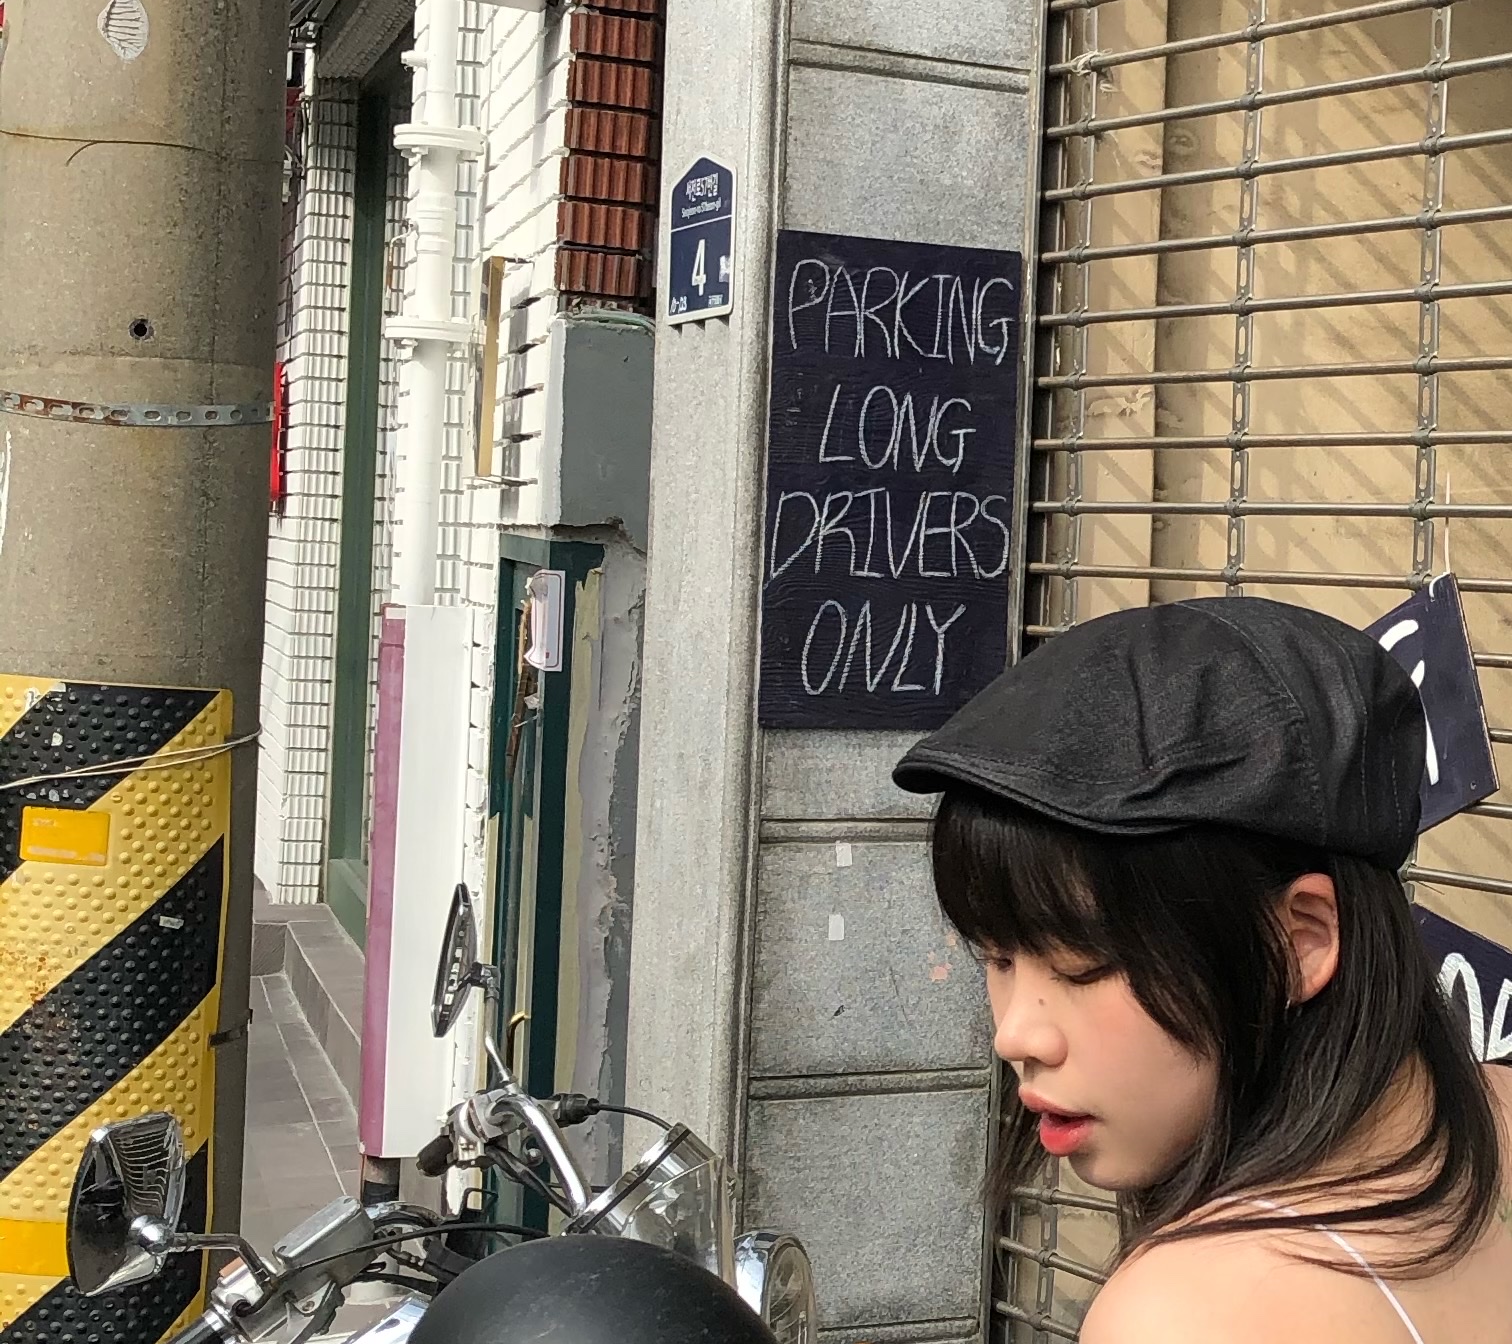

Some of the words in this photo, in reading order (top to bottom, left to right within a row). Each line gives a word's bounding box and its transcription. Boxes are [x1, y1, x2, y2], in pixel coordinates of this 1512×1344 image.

[691, 238, 707, 297] 4
[788, 258, 1015, 365] PARKING
[818, 383, 977, 475] LONG
[770, 487, 1010, 580] DRIVERS
[801, 599, 967, 696] ONLY
